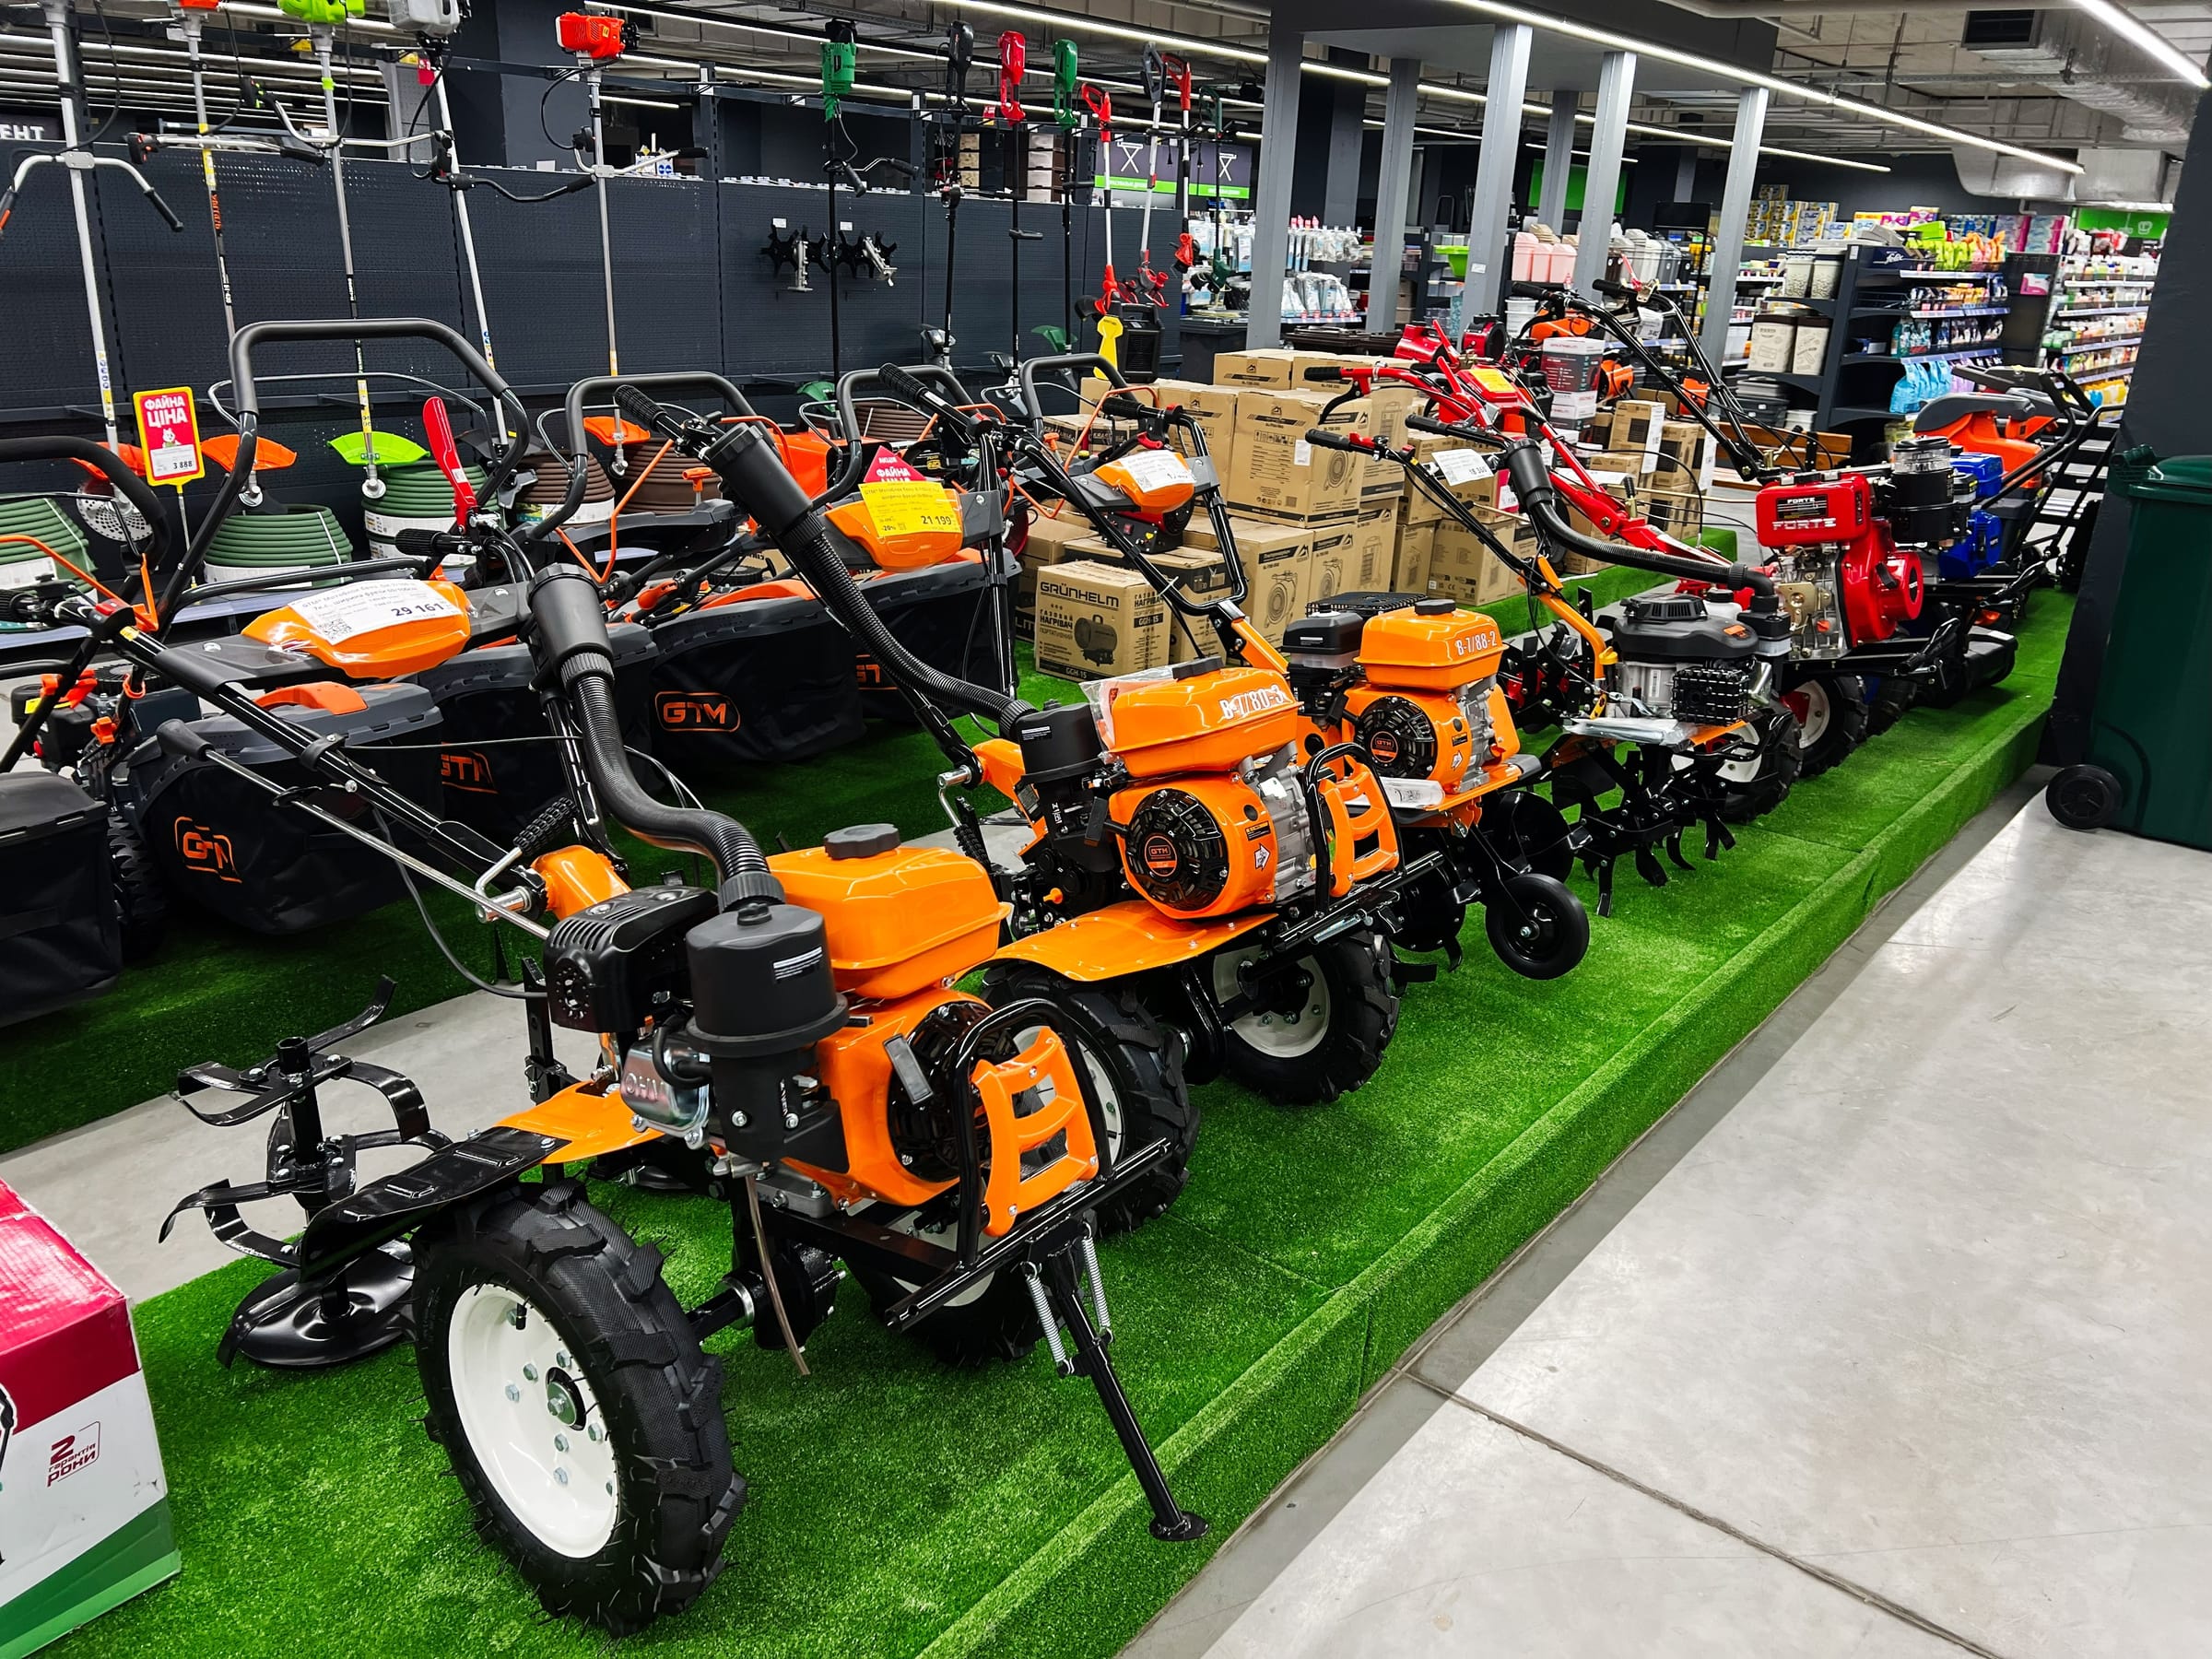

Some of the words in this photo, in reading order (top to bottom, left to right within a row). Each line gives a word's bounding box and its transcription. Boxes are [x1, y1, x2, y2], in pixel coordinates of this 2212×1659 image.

[144, 394, 186, 411] ФАЙНА
[147, 407, 188, 429] ЦІНА
[876, 466, 911, 477] ФАЙНА
[921, 515, 934, 524] 21
[935, 516, 952, 525] 199
[1771, 517, 1837, 531] FORTE
[1040, 581, 1120, 608] GRÜNHELM
[391, 606, 413, 617] 29
[415, 603, 444, 613] 161
[1040, 615, 1073, 629] НАГРІВАЧ
[663, 701, 726, 724] GTM
[50, 1434, 76, 1465] 2
